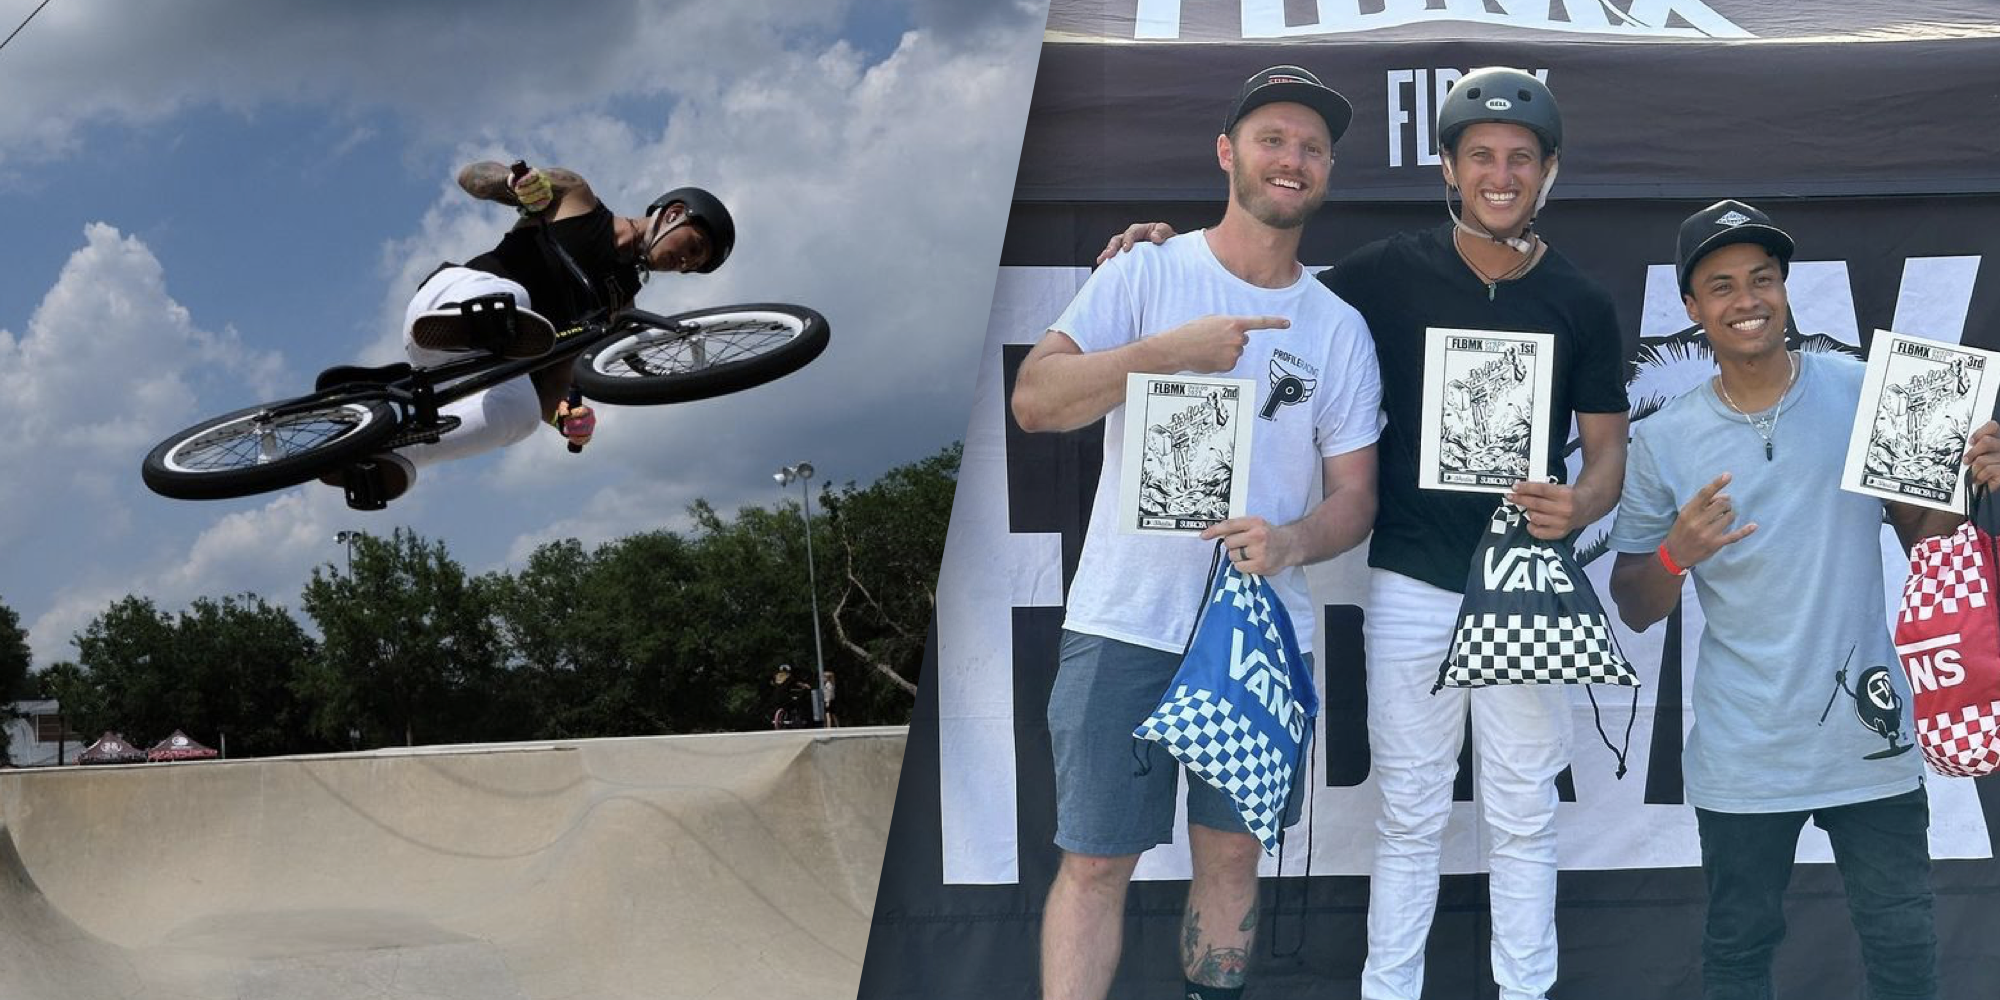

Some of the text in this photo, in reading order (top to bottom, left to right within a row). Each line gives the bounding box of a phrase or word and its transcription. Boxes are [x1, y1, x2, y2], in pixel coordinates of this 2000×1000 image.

[1452, 338, 1483, 351] FLBMX
[1520, 342, 1535, 354] 1st
[1897, 342, 1931, 358] FLBMX
[1967, 355, 1984, 368] 3rd
[1154, 382, 1186, 395] FLBMX
[1221, 386, 1238, 398] 2nd
[1483, 544, 1575, 594] VANS
[1229, 627, 1304, 744] VANS
[1902, 641, 1966, 695] NS
